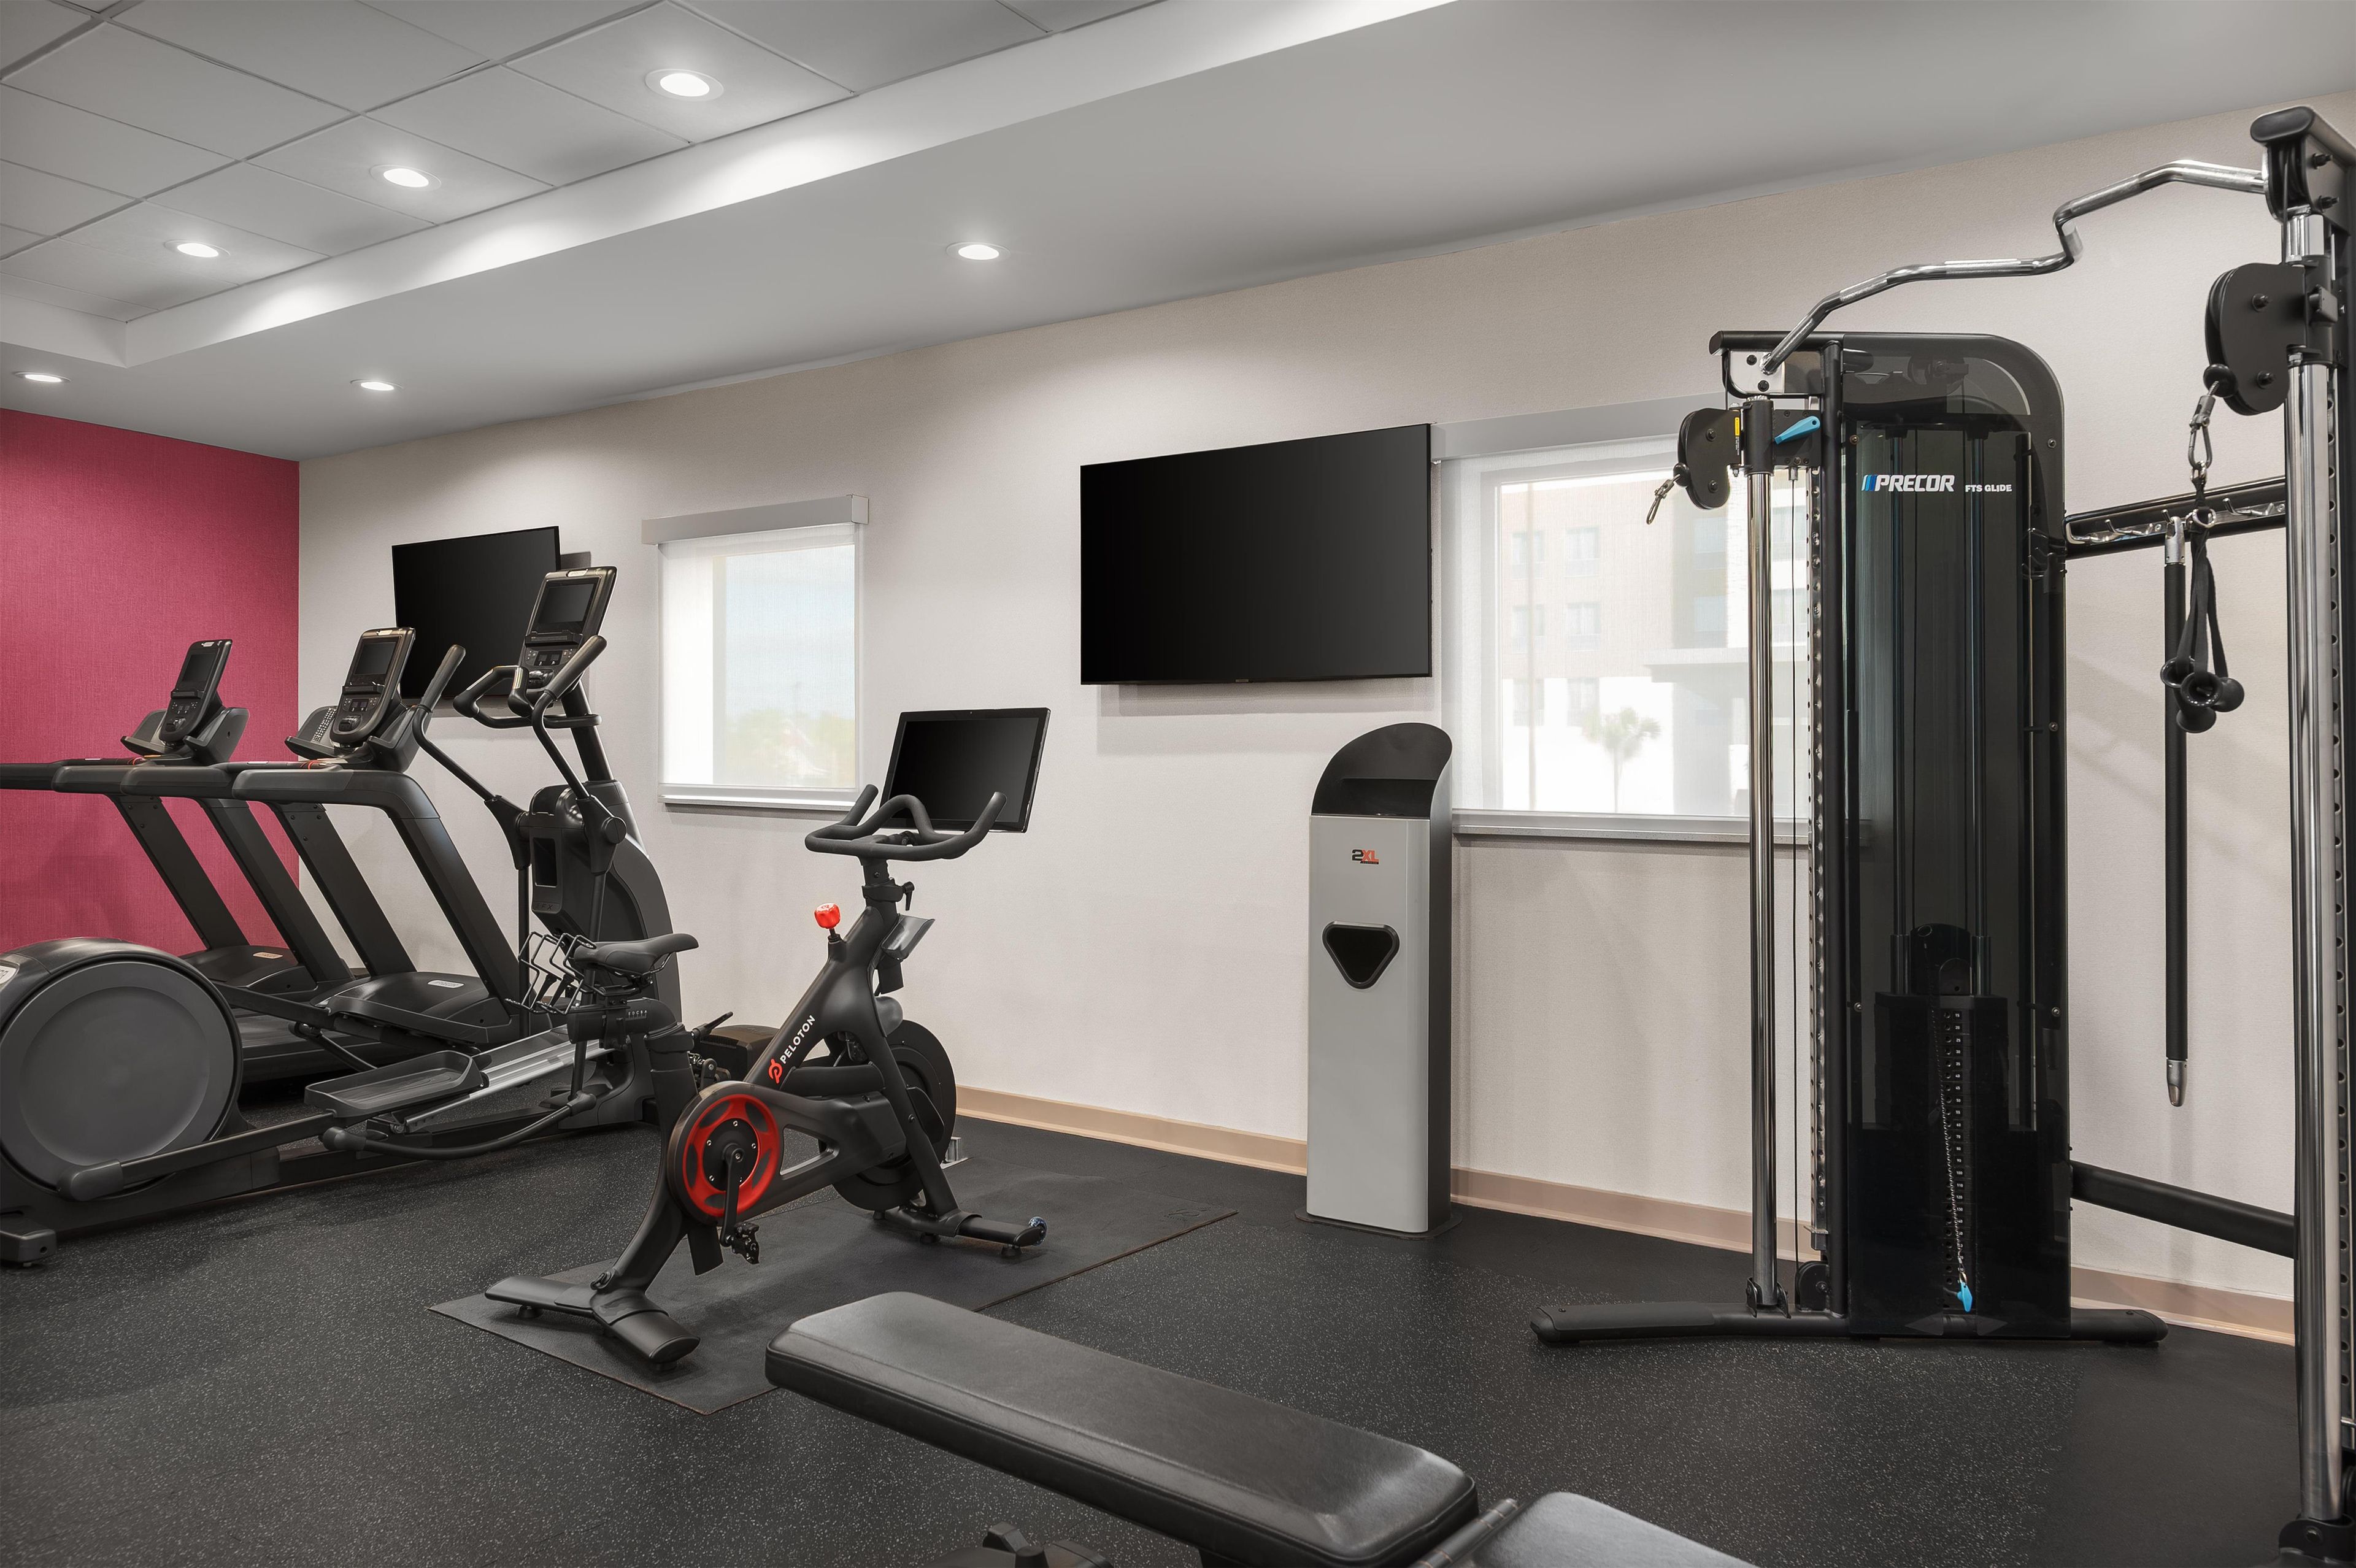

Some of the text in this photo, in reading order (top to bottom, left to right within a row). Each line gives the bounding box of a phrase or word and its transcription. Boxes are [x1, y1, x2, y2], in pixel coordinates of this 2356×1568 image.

[1874, 475, 1955, 492] PRECOR
[1352, 849, 1379, 863] 2XL
[780, 1015, 815, 1064] PELOTON
